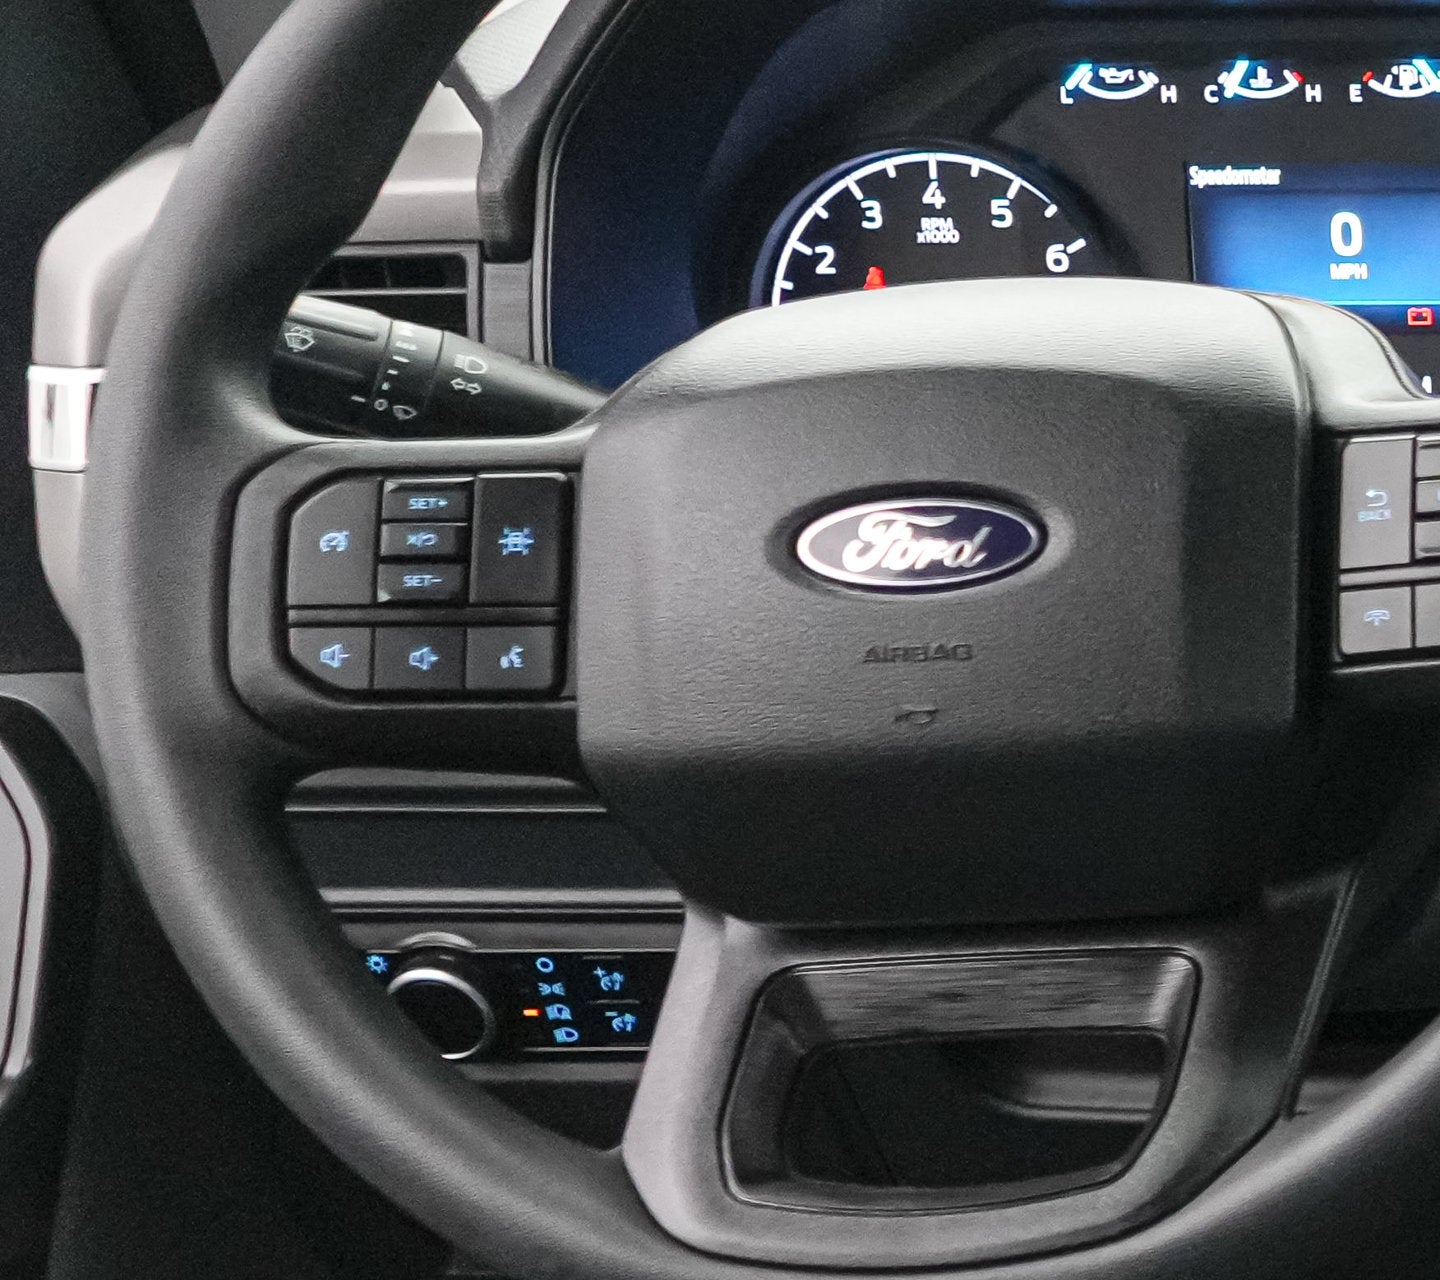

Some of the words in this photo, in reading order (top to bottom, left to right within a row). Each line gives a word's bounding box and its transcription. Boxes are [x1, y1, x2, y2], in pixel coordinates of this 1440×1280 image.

[1060, 86, 1073, 104] L
[1161, 85, 1177, 104] H
[1204, 85, 1219, 104] C
[1305, 84, 1322, 103] H
[1349, 84, 1363, 103] E
[1189, 166, 1282, 189] Speedometer
[922, 180, 946, 210] 4
[860, 198, 883, 229] 3
[990, 198, 1013, 228] 5
[920, 217, 954, 231] RPM
[1330, 211, 1363, 257] 0
[814, 245, 837, 275] 2
[1045, 243, 1070, 273] 6
[1329, 263, 1369, 280] MPH
[1357, 508, 1393, 521] BACK
[842, 510, 992, 573] Ford
[862, 642, 974, 663] AIRBAG
